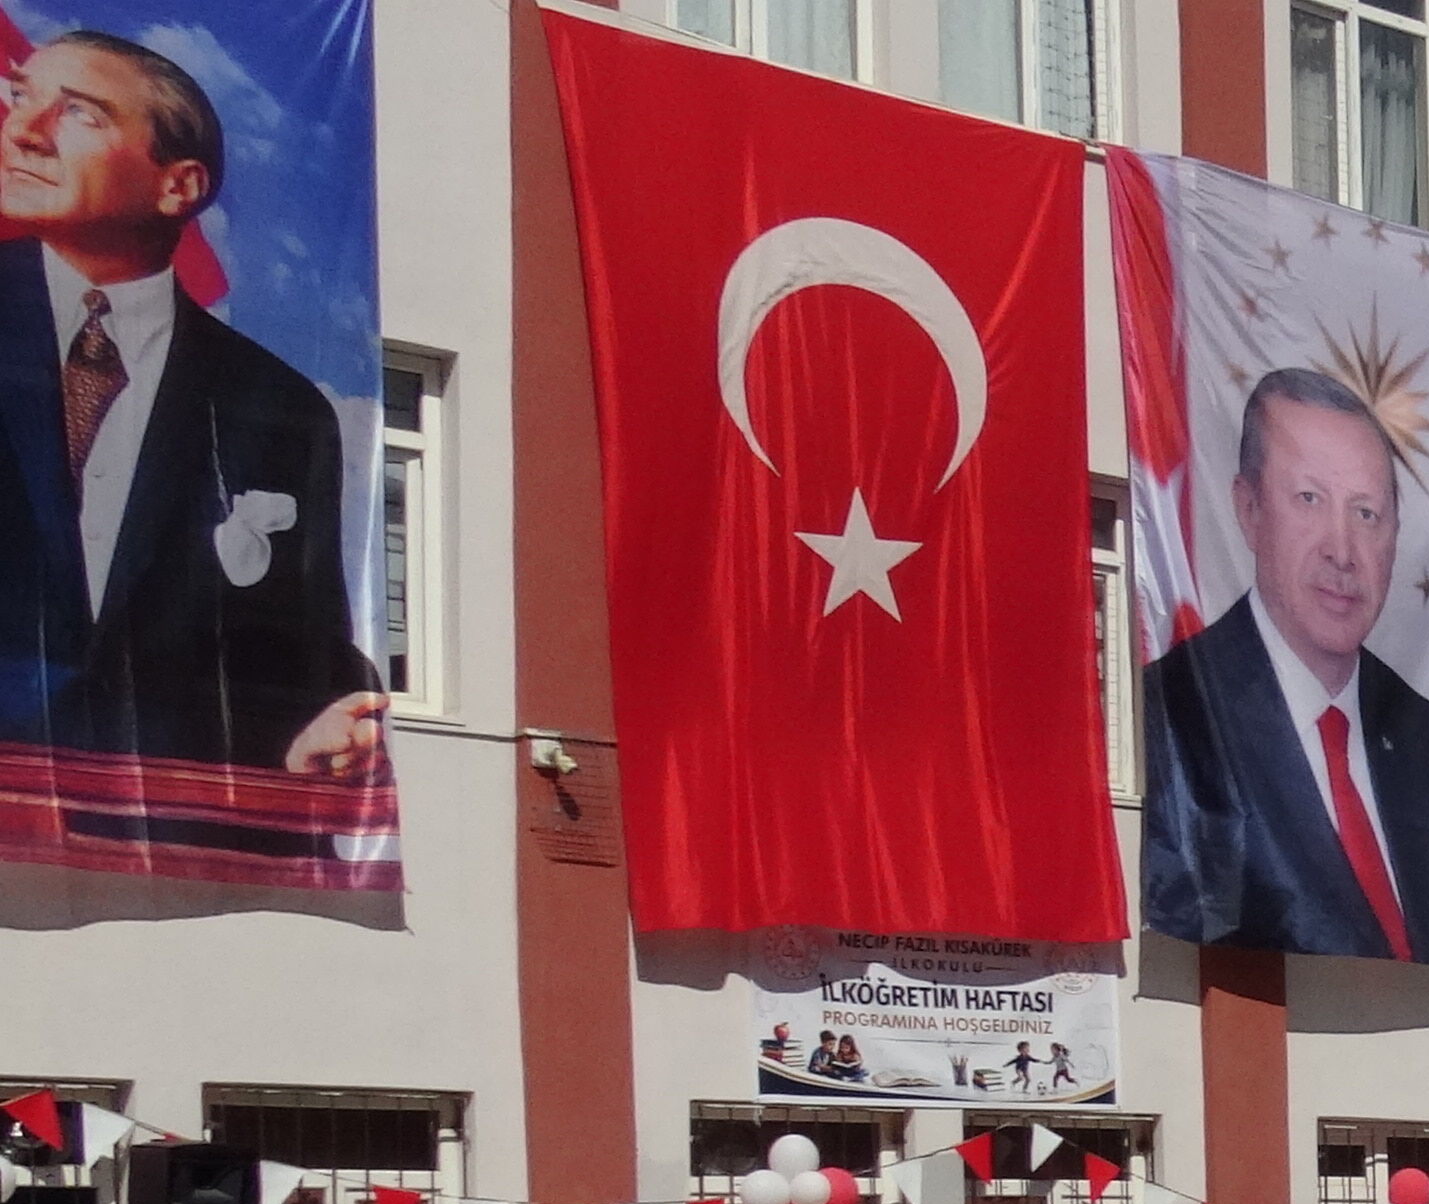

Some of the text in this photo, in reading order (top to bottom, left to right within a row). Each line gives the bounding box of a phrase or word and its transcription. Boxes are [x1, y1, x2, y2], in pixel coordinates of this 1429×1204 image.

[895, 936, 939, 953] FAZIL
[944, 938, 1032, 958] KISAKÜREK
[821, 972, 1053, 1013] İLKÖĞRETİM HAFTASI
[822, 1010, 1053, 1036] PROGRAMINA HOŞGELDİNİZ
